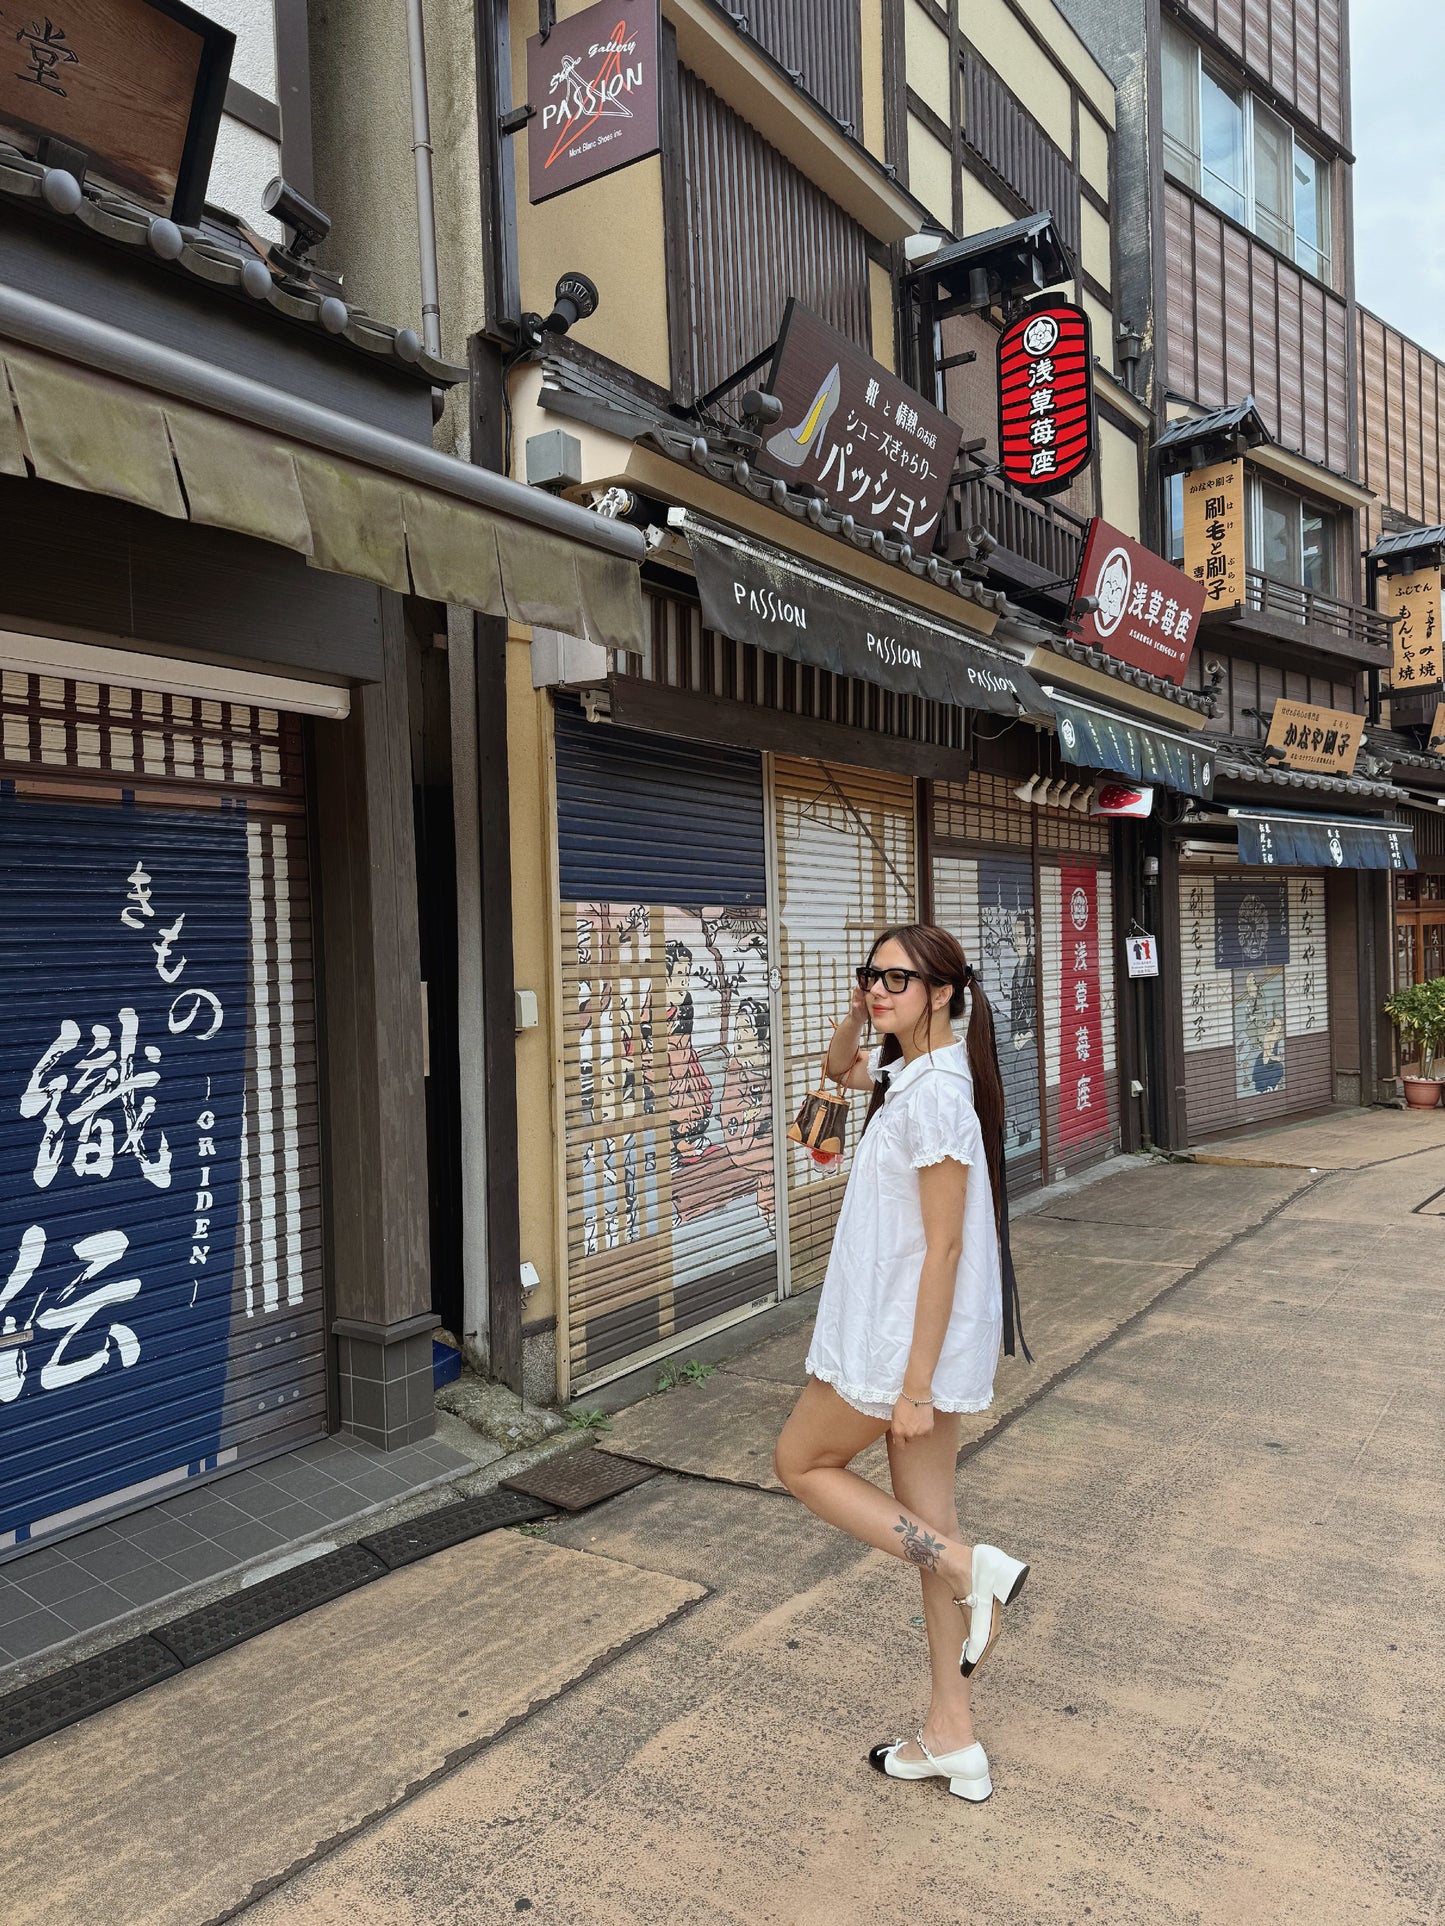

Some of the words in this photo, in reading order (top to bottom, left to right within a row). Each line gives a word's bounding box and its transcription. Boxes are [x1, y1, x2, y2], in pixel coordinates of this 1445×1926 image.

[588, 41, 637, 58] Gallery
[542, 62, 643, 130] PASSION
[569, 147, 582, 158] Mont
[582, 140, 597, 152] Blanc
[597, 133, 614, 145] Shoes
[1027, 357, 1057, 477] 浅草苺座
[817, 443, 939, 538] パッション
[1205, 495, 1227, 601] 刷毛と刷子
[733, 581, 807, 630] PASSION
[866, 632, 922, 669] PASSION
[967, 667, 1018, 694] PASSION
[120, 860, 224, 1041] きもの
